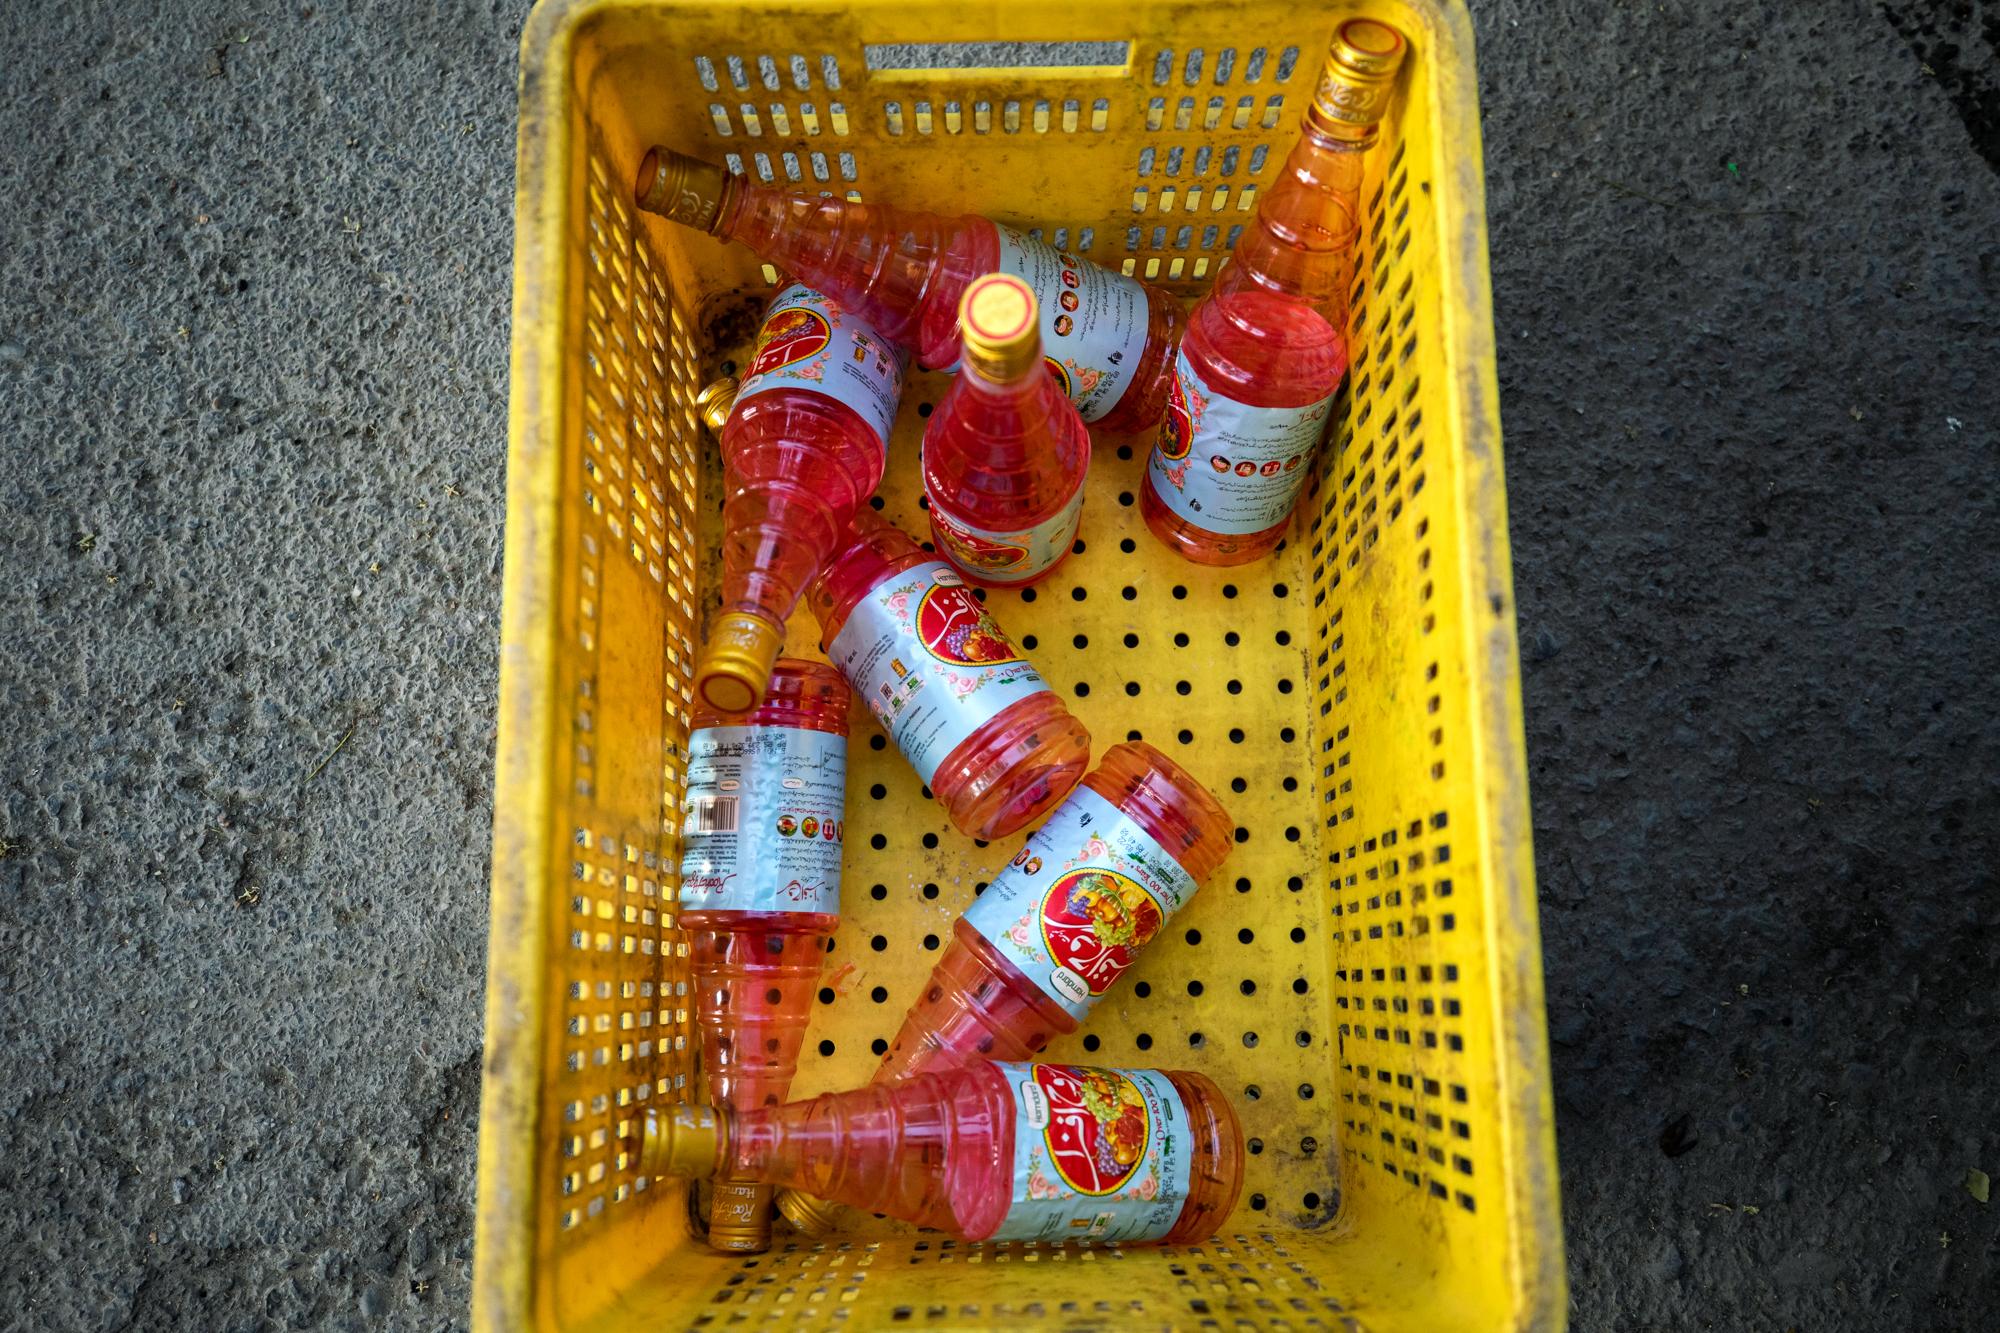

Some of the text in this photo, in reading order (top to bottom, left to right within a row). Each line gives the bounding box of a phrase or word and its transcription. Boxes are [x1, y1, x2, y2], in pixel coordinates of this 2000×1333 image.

[1135, 865, 1151, 884] Years
[1149, 880, 1162, 893] 100
[1160, 890, 1173, 905] Over
[1056, 971, 1086, 998] Hamdard
[1028, 1086, 1044, 1122] Hamdard
[1150, 1099, 1160, 1114] 100
[1155, 1116, 1165, 1140] Over
